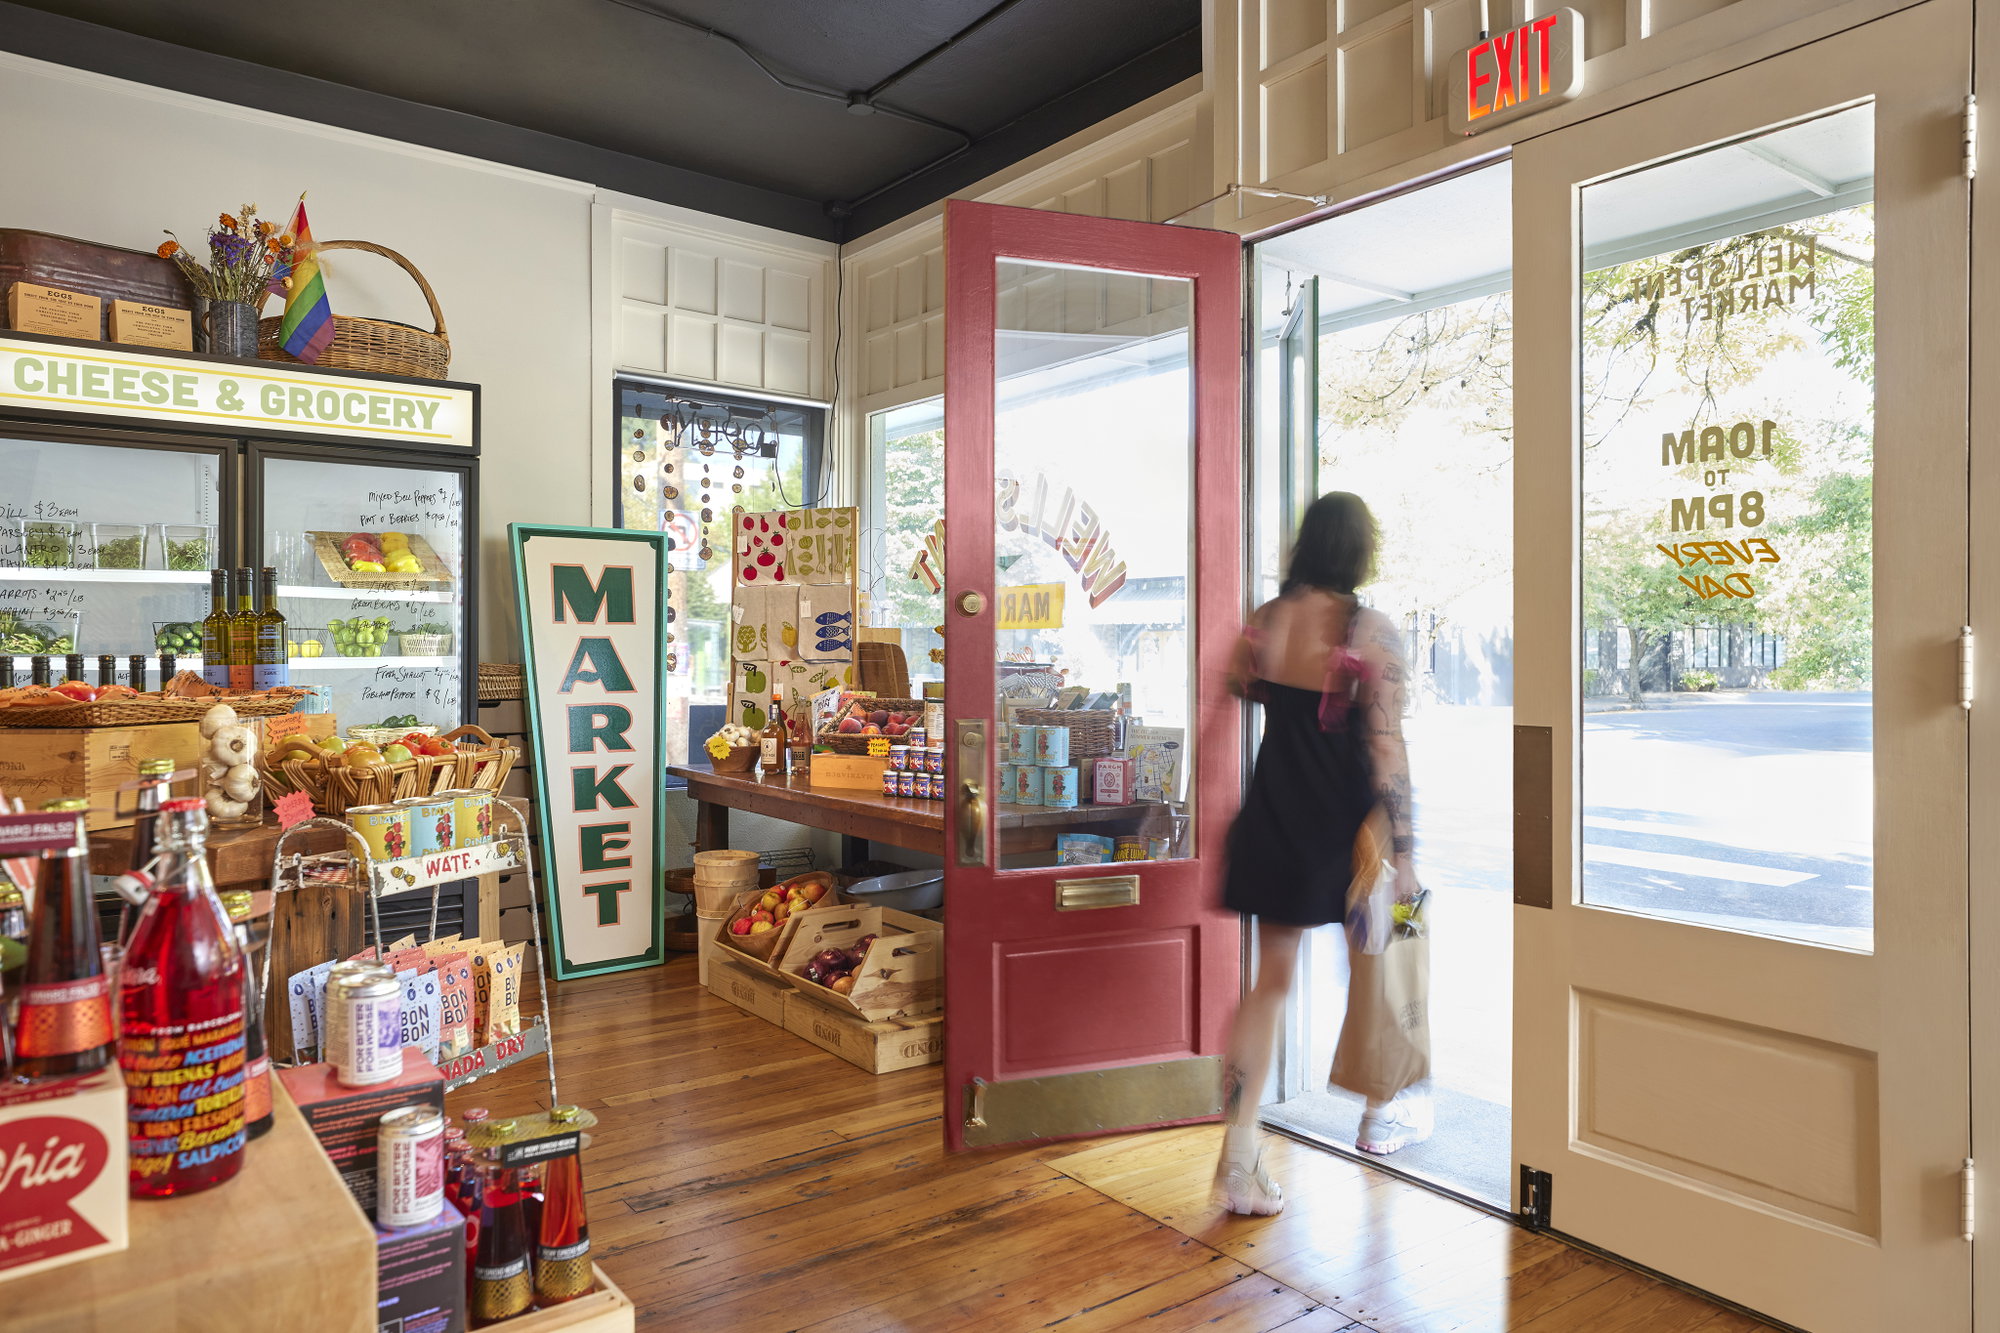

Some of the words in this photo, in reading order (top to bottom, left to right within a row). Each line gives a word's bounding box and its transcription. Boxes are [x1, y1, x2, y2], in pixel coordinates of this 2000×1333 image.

[1467, 15, 1557, 121] EXIT
[48, 290, 72, 300] EGGS
[142, 306, 165, 314] EGGS
[14, 357, 199, 408] CHEESE
[215, 379, 246, 413] &
[260, 383, 441, 430] GROCERY
[550, 563, 639, 928] MARKET
[356, 1003, 364, 1046] BITTER
[366, 1003, 374, 1045] WORSE
[400, 1003, 429, 1027] BON
[400, 1020, 430, 1044] BON
[356, 1048, 364, 1073] FOR
[366, 1047, 374, 1072] FOR
[439, 1050, 486, 1081] NADA
[495, 1033, 527, 1061] DRY
[901, 1038, 945, 1060] OND
[393, 1143, 401, 1186] BITTER
[402, 1143, 410, 1186] WORSE
[393, 1188, 401, 1214] FOR
[402, 1188, 410, 1213] FOR
